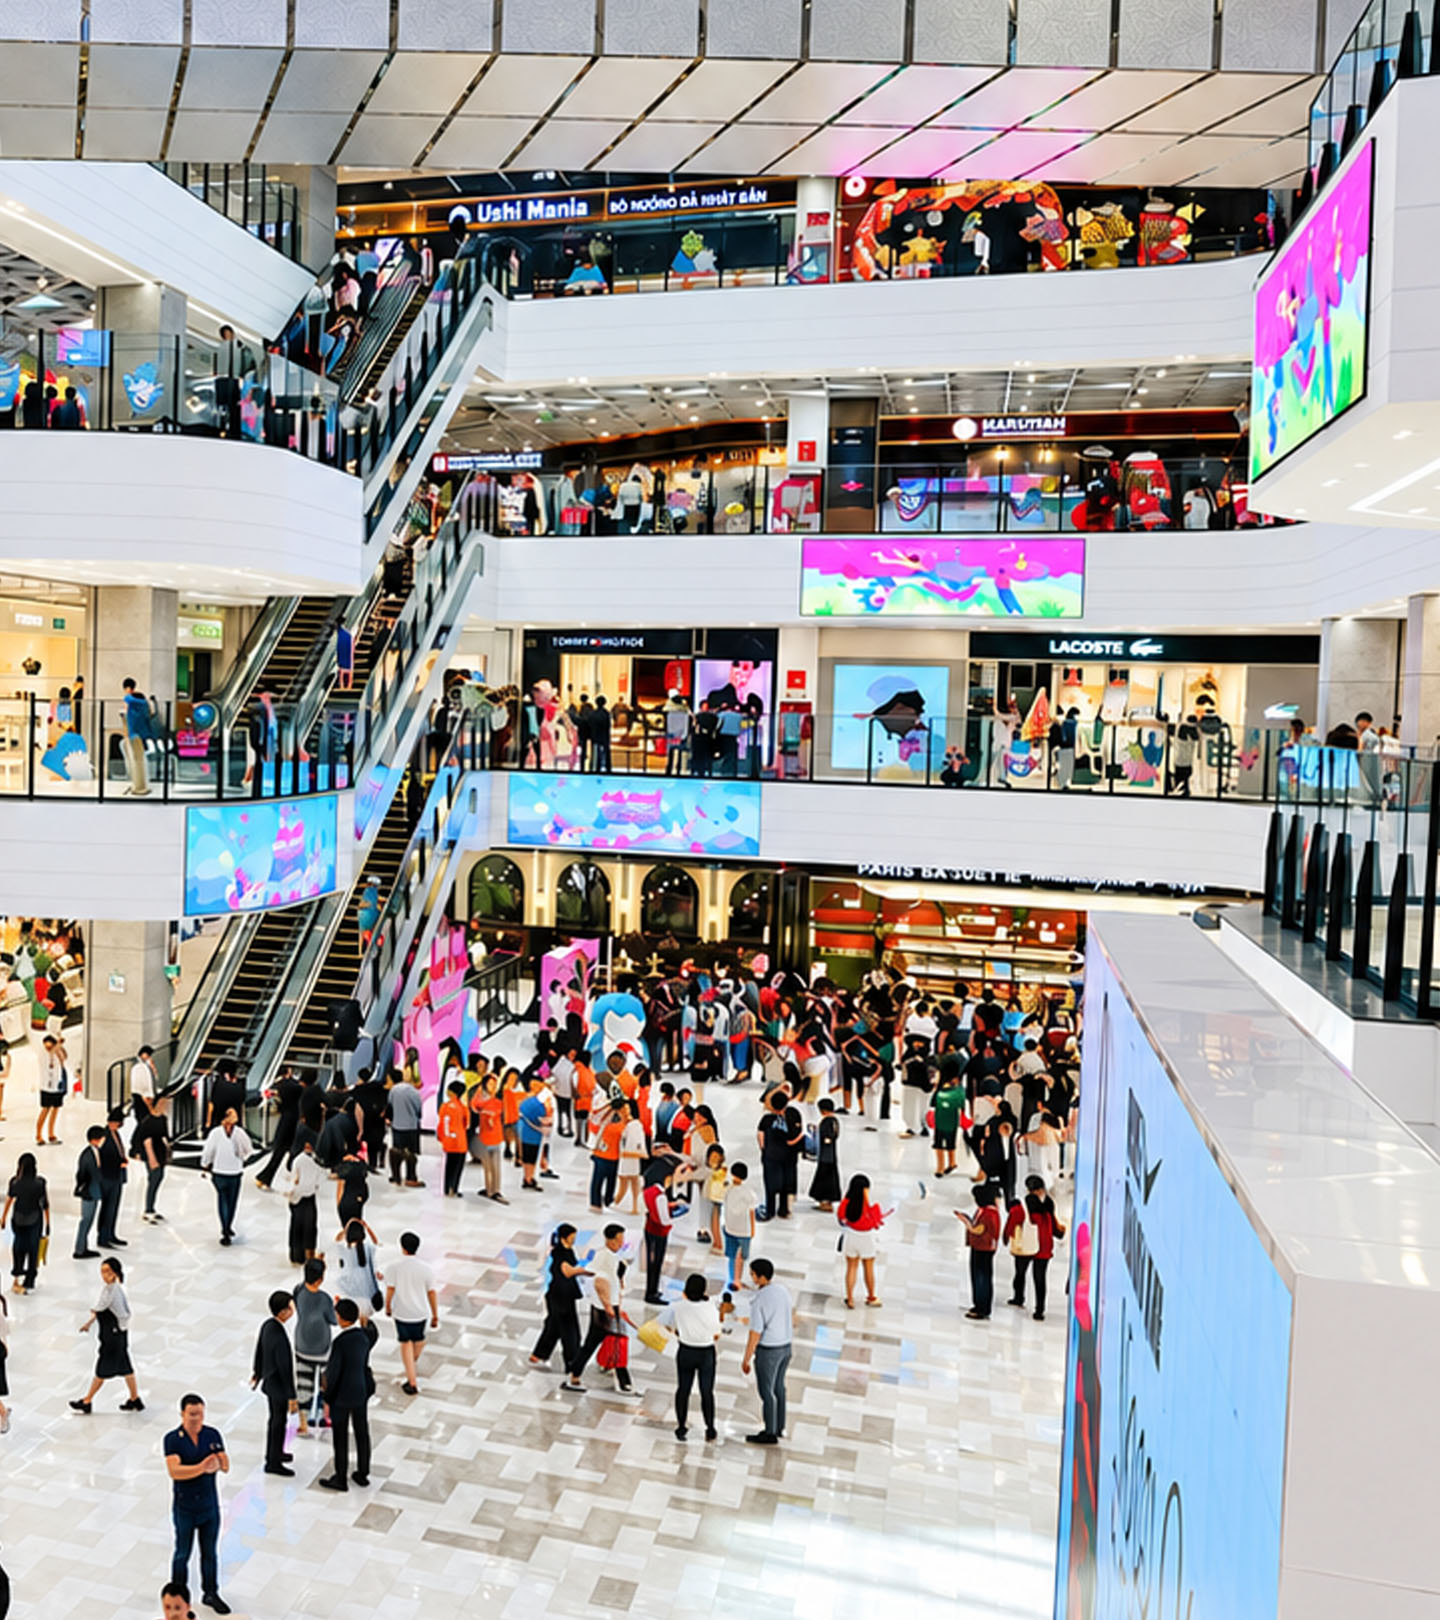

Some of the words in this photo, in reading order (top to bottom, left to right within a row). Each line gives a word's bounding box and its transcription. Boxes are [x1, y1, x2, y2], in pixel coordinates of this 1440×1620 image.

[477, 200, 521, 223] Ushi
[527, 197, 589, 220] Mania
[1049, 639, 1124, 655] LACOSTE
